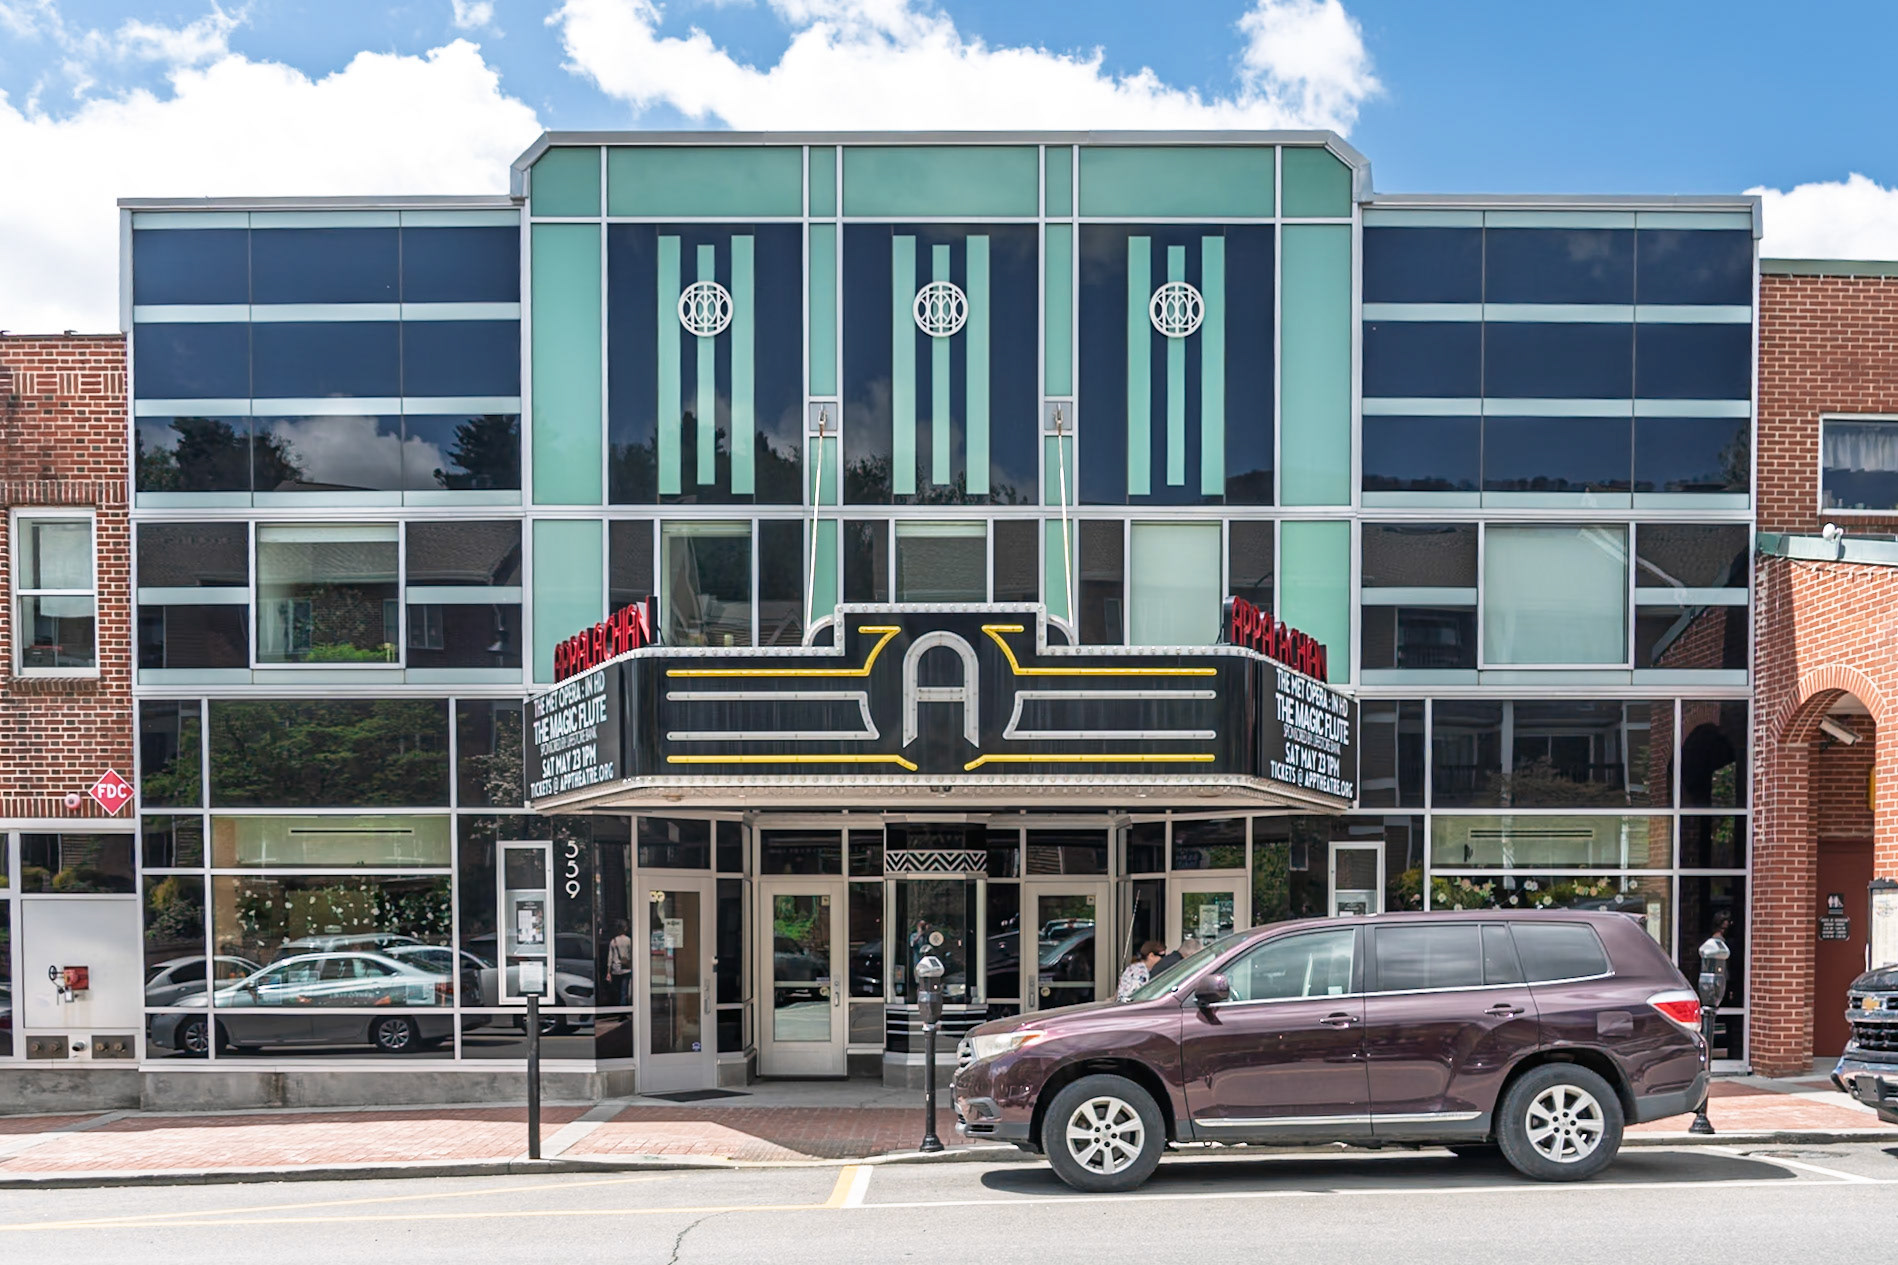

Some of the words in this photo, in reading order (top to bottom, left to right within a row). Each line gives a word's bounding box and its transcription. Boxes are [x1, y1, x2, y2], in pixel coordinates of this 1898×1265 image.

[554, 595, 650, 684] APPALACHIAN
[1232, 595, 1327, 683] APPALACHIAN
[534, 697, 546, 718] THE
[546, 690, 558, 714] MET
[559, 681, 581, 708] OPERA
[585, 675, 593, 699] IN
[594, 670, 606, 694] HD
[903, 630, 979, 749] A
[1276, 667, 1291, 694] THE
[1291, 674, 1306, 700] MET
[1306, 681, 1328, 710] OPERA
[1331, 692, 1339, 714] IN
[1339, 696, 1349, 718] HD
[533, 717, 549, 746] THE
[549, 706, 578, 740] MAGIC
[578, 694, 608, 730] FLUTE
[1275, 692, 1294, 725] THE
[1295, 700, 1324, 736] MAGIC
[1325, 712, 1350, 746] FLUTE
[530, 778, 552, 799] TICKETS
[552, 776, 559, 795] @
[560, 761, 614, 791] APPTHEATRE.ORG
[542, 756, 555, 779] SAT
[555, 750, 571, 775] MAY
[572, 748, 581, 770] 23
[582, 742, 597, 768] 1PM
[1270, 759, 1296, 784] TICKETS
[1297, 768, 1304, 787] @
[1304, 770, 1353, 799] APPTHEATRE.ORG
[1285, 741, 1300, 766] SAT
[1301, 746, 1317, 771] MAY
[1318, 751, 1326, 774] 23
[1327, 754, 1340, 778] 1PM
[97, 783, 128, 799] FDC
[564, 840, 581, 899] 559
